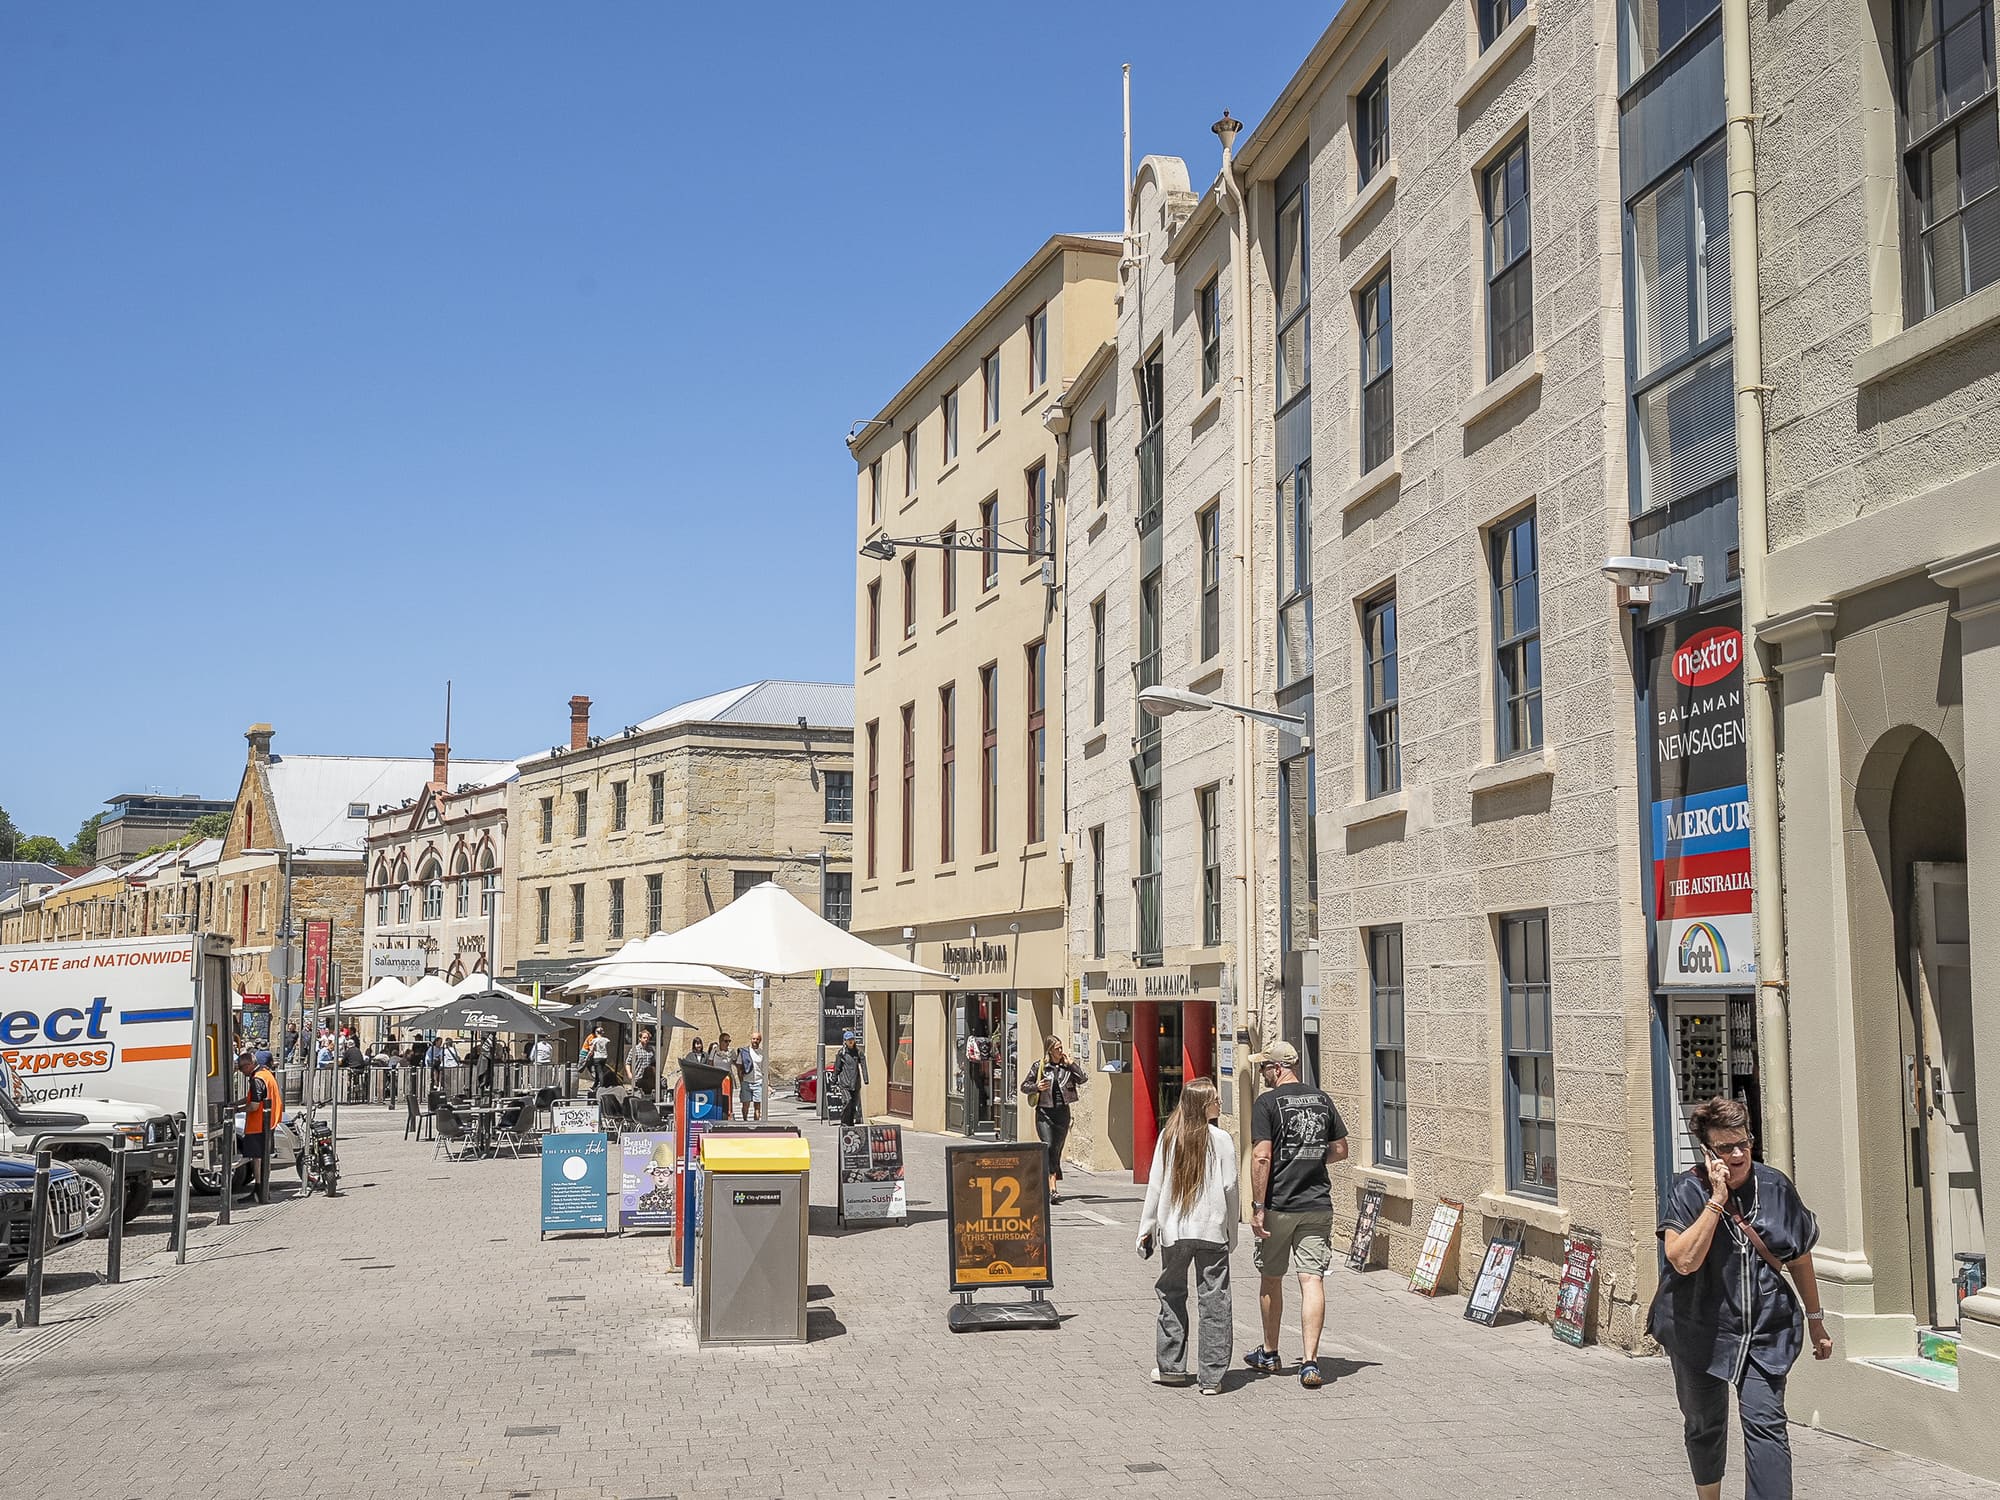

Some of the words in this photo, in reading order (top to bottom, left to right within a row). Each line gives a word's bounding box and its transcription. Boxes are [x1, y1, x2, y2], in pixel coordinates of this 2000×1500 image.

[1678, 637, 1737, 678] nextra
[1658, 690, 1740, 726] SALAMAN
[1658, 718, 1745, 763] NEWSAGEN
[1667, 801, 1750, 841] MERCUR
[1669, 878, 1690, 897] THE
[1691, 871, 1753, 894] AUSTRALIA
[9, 958, 60, 973] STATE
[62, 956, 91, 970] and
[93, 950, 192, 967] NATIONWIDE
[374, 957, 420, 966] Salamanca
[1679, 945, 1712, 973] Lott
[1145, 974, 1190, 997] SALAMANCA
[0, 997, 113, 1046] ect
[824, 1008, 856, 1016] WHALER
[2, 1050, 109, 1074] Express
[30, 1083, 83, 1102] rgent!
[695, 1093, 708, 1113] P
[623, 1136, 652, 1148] Beauty
[632, 1146, 651, 1155] Bees
[872, 1194, 894, 1203] Sushi
[968, 1176, 1021, 1219] $12
[966, 1218, 1031, 1233] MILLION
[967, 1233, 985, 1241] THIS
[988, 1233, 1030, 1241] THURSDAY
